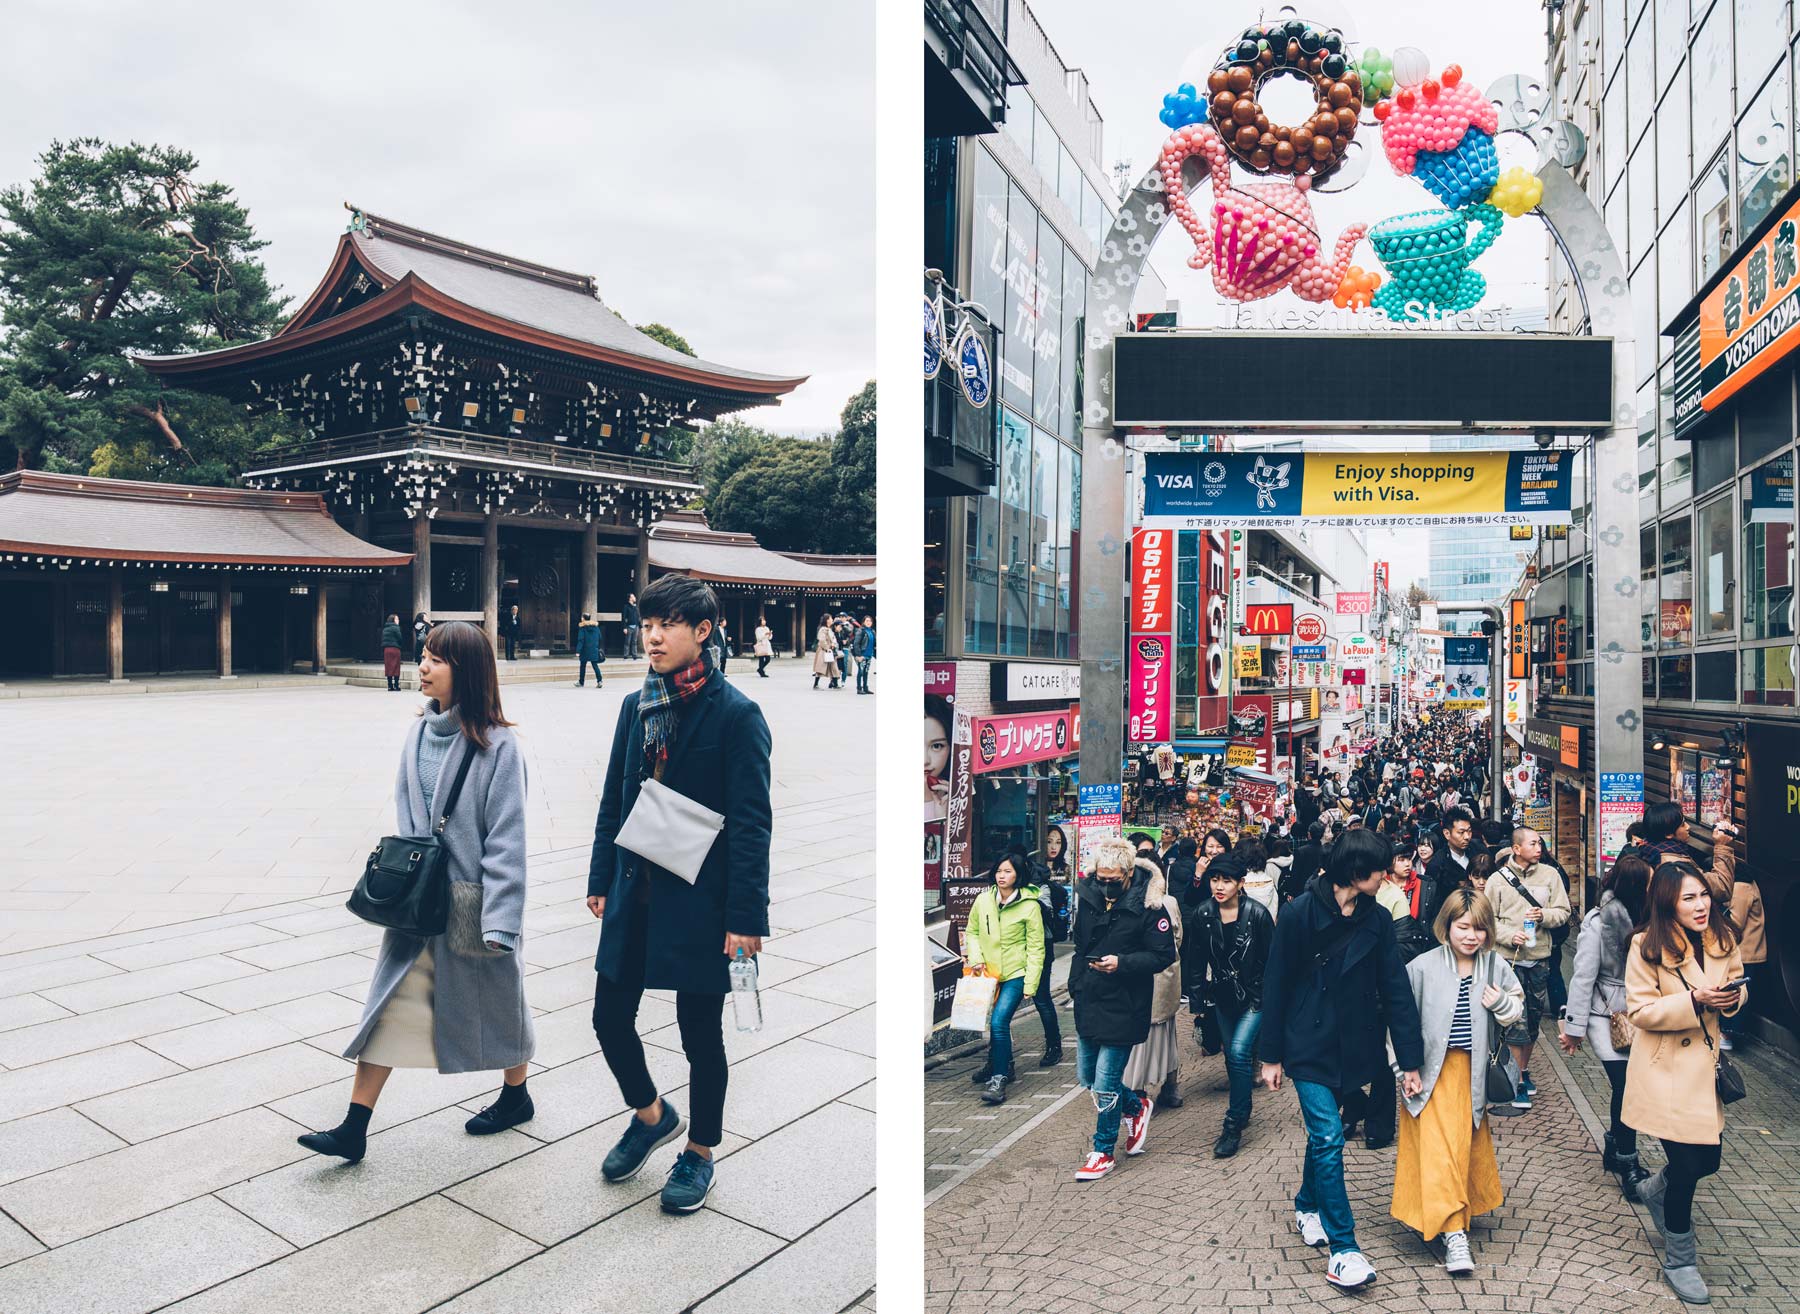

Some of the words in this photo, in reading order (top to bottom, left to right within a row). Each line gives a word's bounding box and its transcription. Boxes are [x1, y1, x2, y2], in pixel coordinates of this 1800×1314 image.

[990, 238, 1052, 316] LASER
[1217, 299, 1389, 331] Takeshita
[1404, 301, 1514, 331] Street
[1725, 293, 1800, 375] YOSHINOYA
[1524, 456, 1547, 464] TOKYO
[1335, 463, 1386, 482] Enjoy
[1391, 463, 1475, 482] shopping
[1522, 464, 1558, 472] SHOPPING
[1154, 474, 1194, 489] VISA
[1521, 472, 1542, 481] WEEK
[1521, 480, 1558, 490] HARAJUKU
[1333, 485, 1374, 502] with
[1379, 486, 1420, 501] Visa.
[1193, 500, 1213, 508] sponsor
[1141, 531, 1162, 629] OSドラッグ
[1339, 601, 1367, 613] ¥300
[1514, 624, 1523, 654] 吉野家
[1022, 675, 1038, 688] CAT
[1040, 675, 1059, 688] CAFE
[1507, 681, 1520, 723] プリクラ
[1527, 729, 1549, 749] WOLFGANG
[1548, 735, 1560, 751] PUCK
[1561, 738, 1578, 755] EXPRESS
[1328, 746, 1343, 757] SALE
[1227, 758, 1243, 766] HAPPY
[1244, 757, 1255, 766] ONE
[1194, 763, 1206, 777] 侍
[1235, 787, 1275, 800] スクイーズ
[1787, 783, 1800, 814] P
